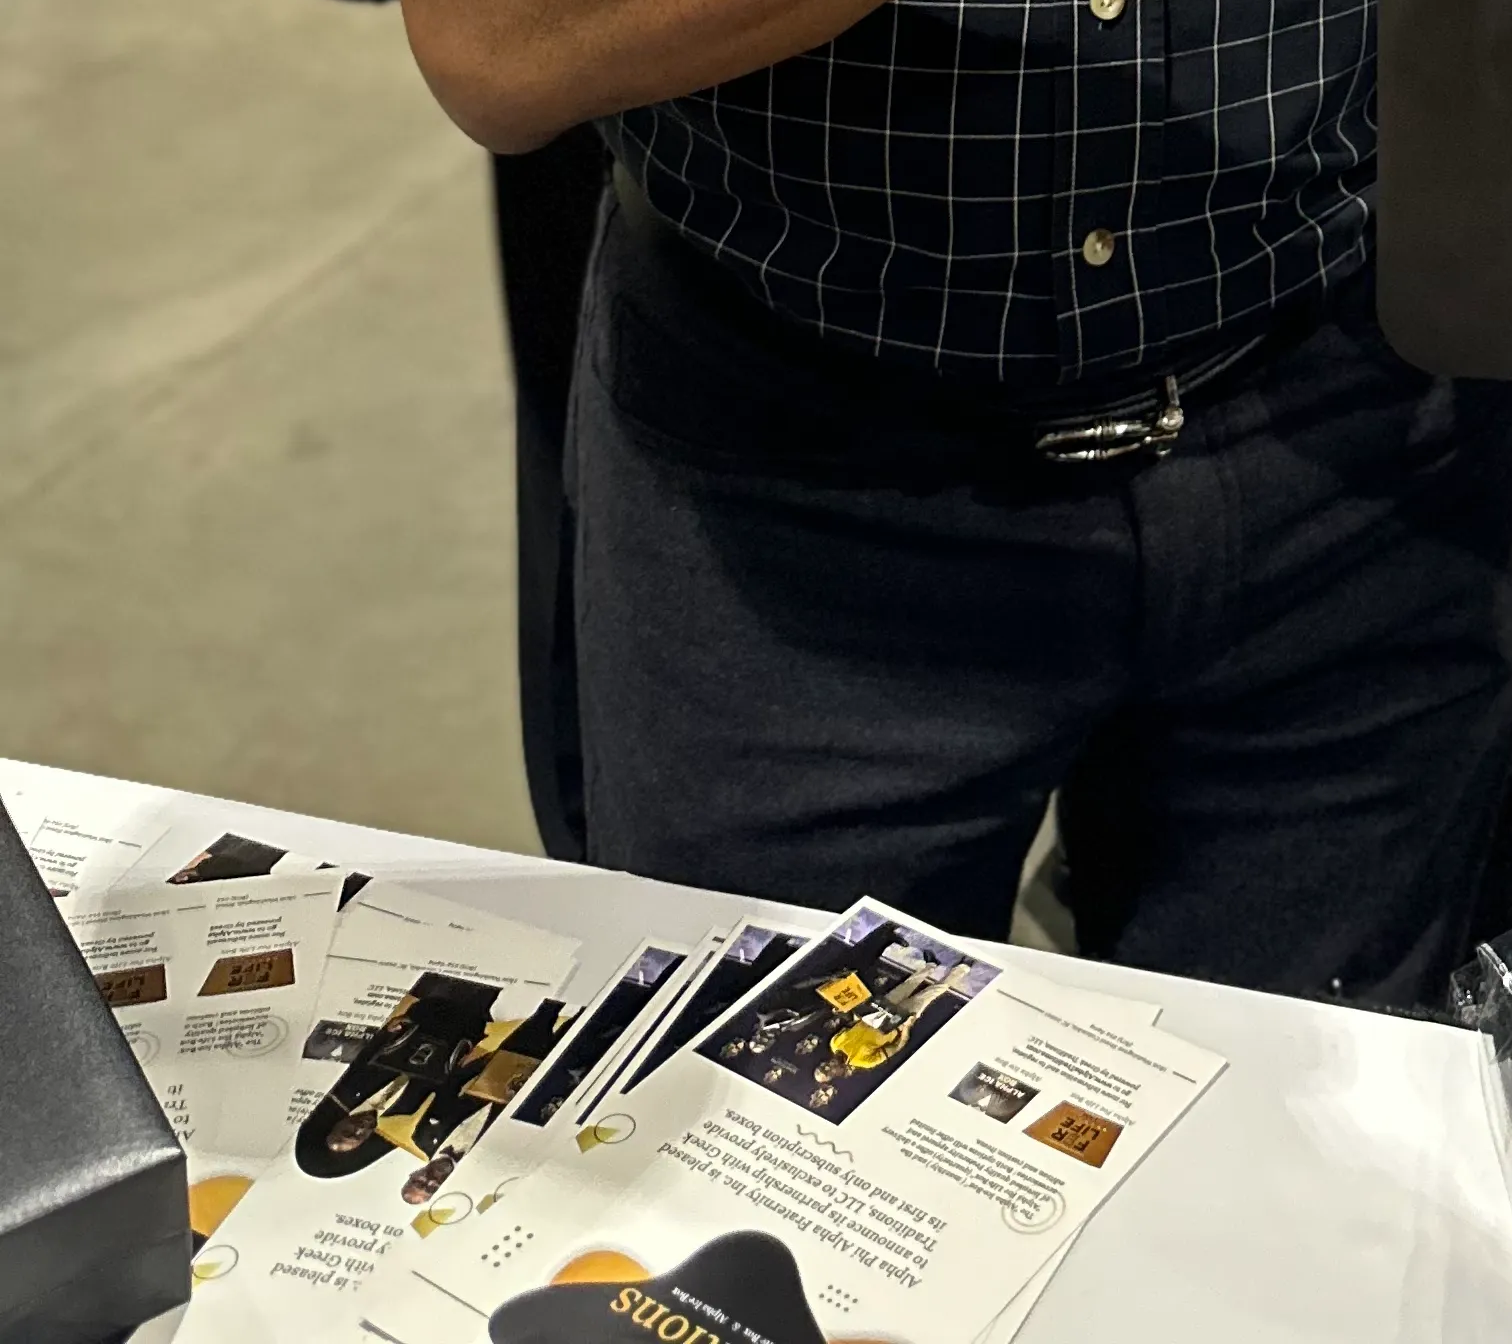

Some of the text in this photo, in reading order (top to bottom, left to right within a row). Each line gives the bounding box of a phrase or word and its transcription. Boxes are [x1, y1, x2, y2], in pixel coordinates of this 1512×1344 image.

[978, 1072, 1024, 1098] ALPHA ICE
[172, 1113, 189, 1124] to
[1060, 1113, 1100, 1142] LIFE
[657, 1137, 711, 1176] pleased
[723, 1107, 946, 1233] its first and only subscription boxes.
[702, 1116, 937, 1252] Traditions, LLC to exclusively provide
[707, 1167, 721, 1181] is
[681, 1131, 927, 1270] to announce its partnership with Greek
[744, 1184, 813, 1231] Fraternity
[332, 1213, 381, 1236] boxes.
[811, 1220, 855, 1254] Alpha
[312, 1227, 377, 1254] provide
[851, 1245, 878, 1267] Phi
[292, 1245, 342, 1269] Greek
[268, 1258, 348, 1291] is pleased
[877, 1256, 922, 1291] Alpha
